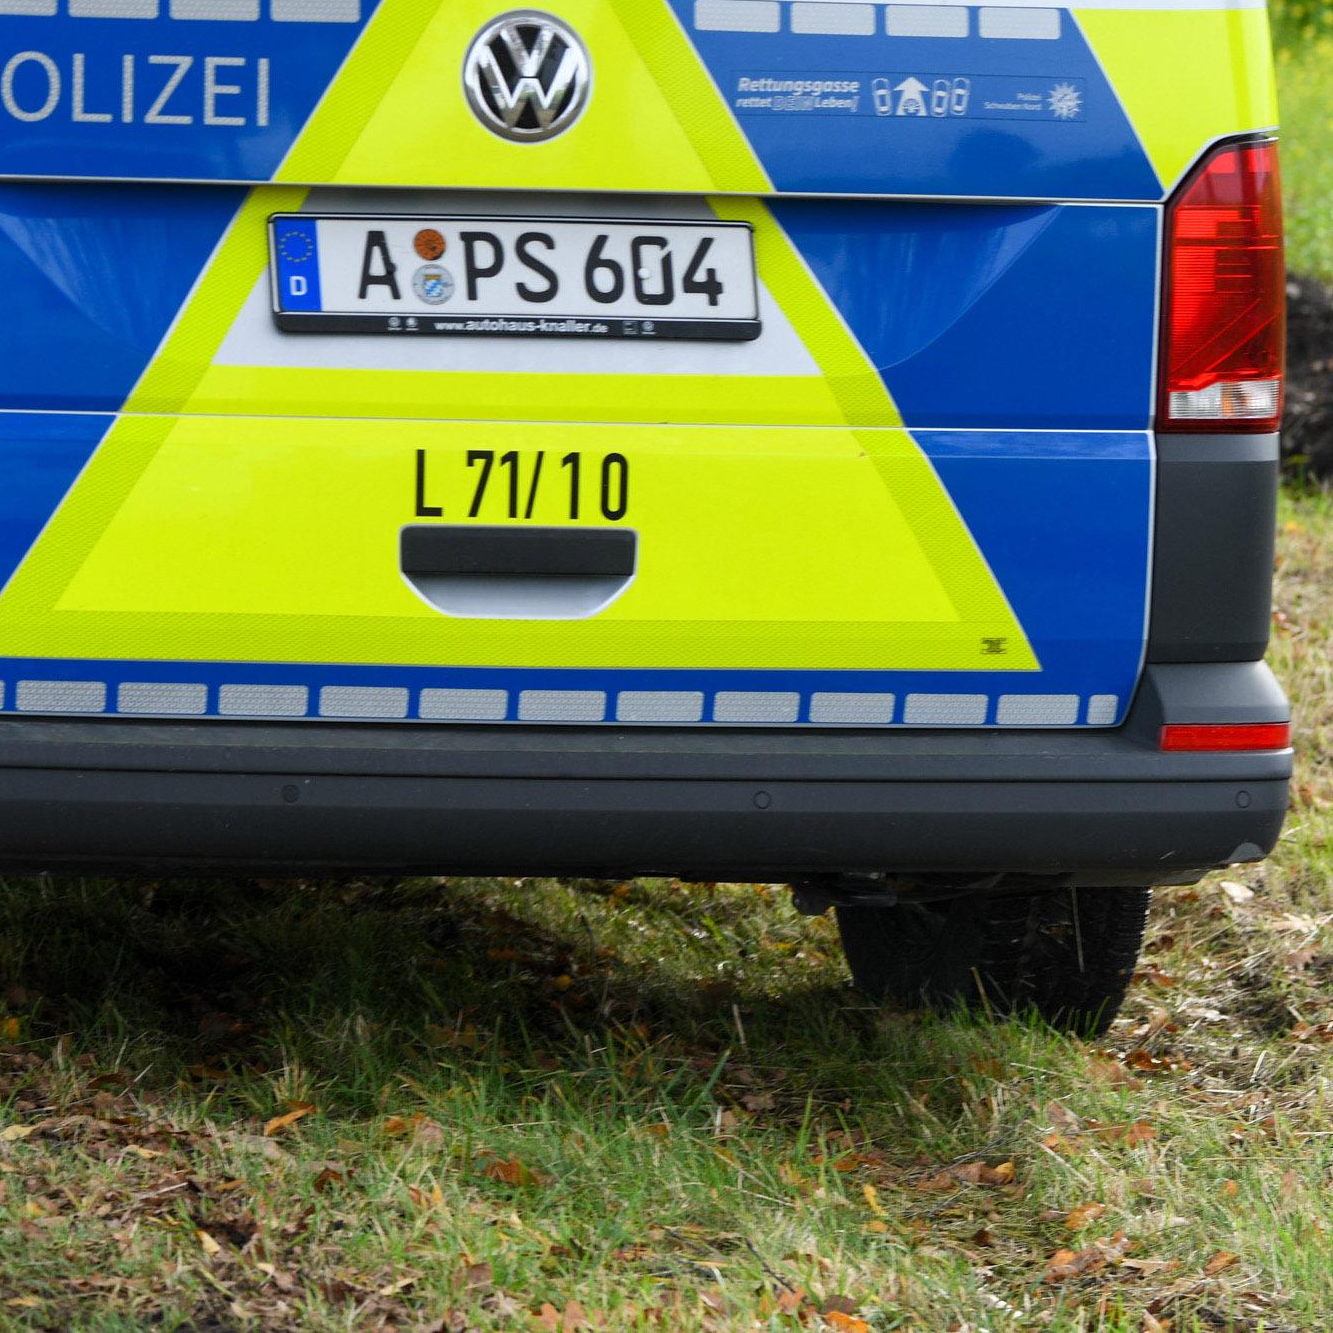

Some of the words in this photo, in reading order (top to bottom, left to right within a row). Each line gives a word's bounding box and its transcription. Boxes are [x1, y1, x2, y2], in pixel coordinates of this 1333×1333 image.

[737, 77, 861, 96] Rettungsgasse
[735, 96, 773, 108] rettet
[358, 230, 402, 301] A
[459, 230, 559, 304] PS
[583, 233, 726, 307] 604
[290, 275, 308, 297] D
[434, 318, 609, 333] www.autohaus-knaller.de
[415, 448, 443, 517] L
